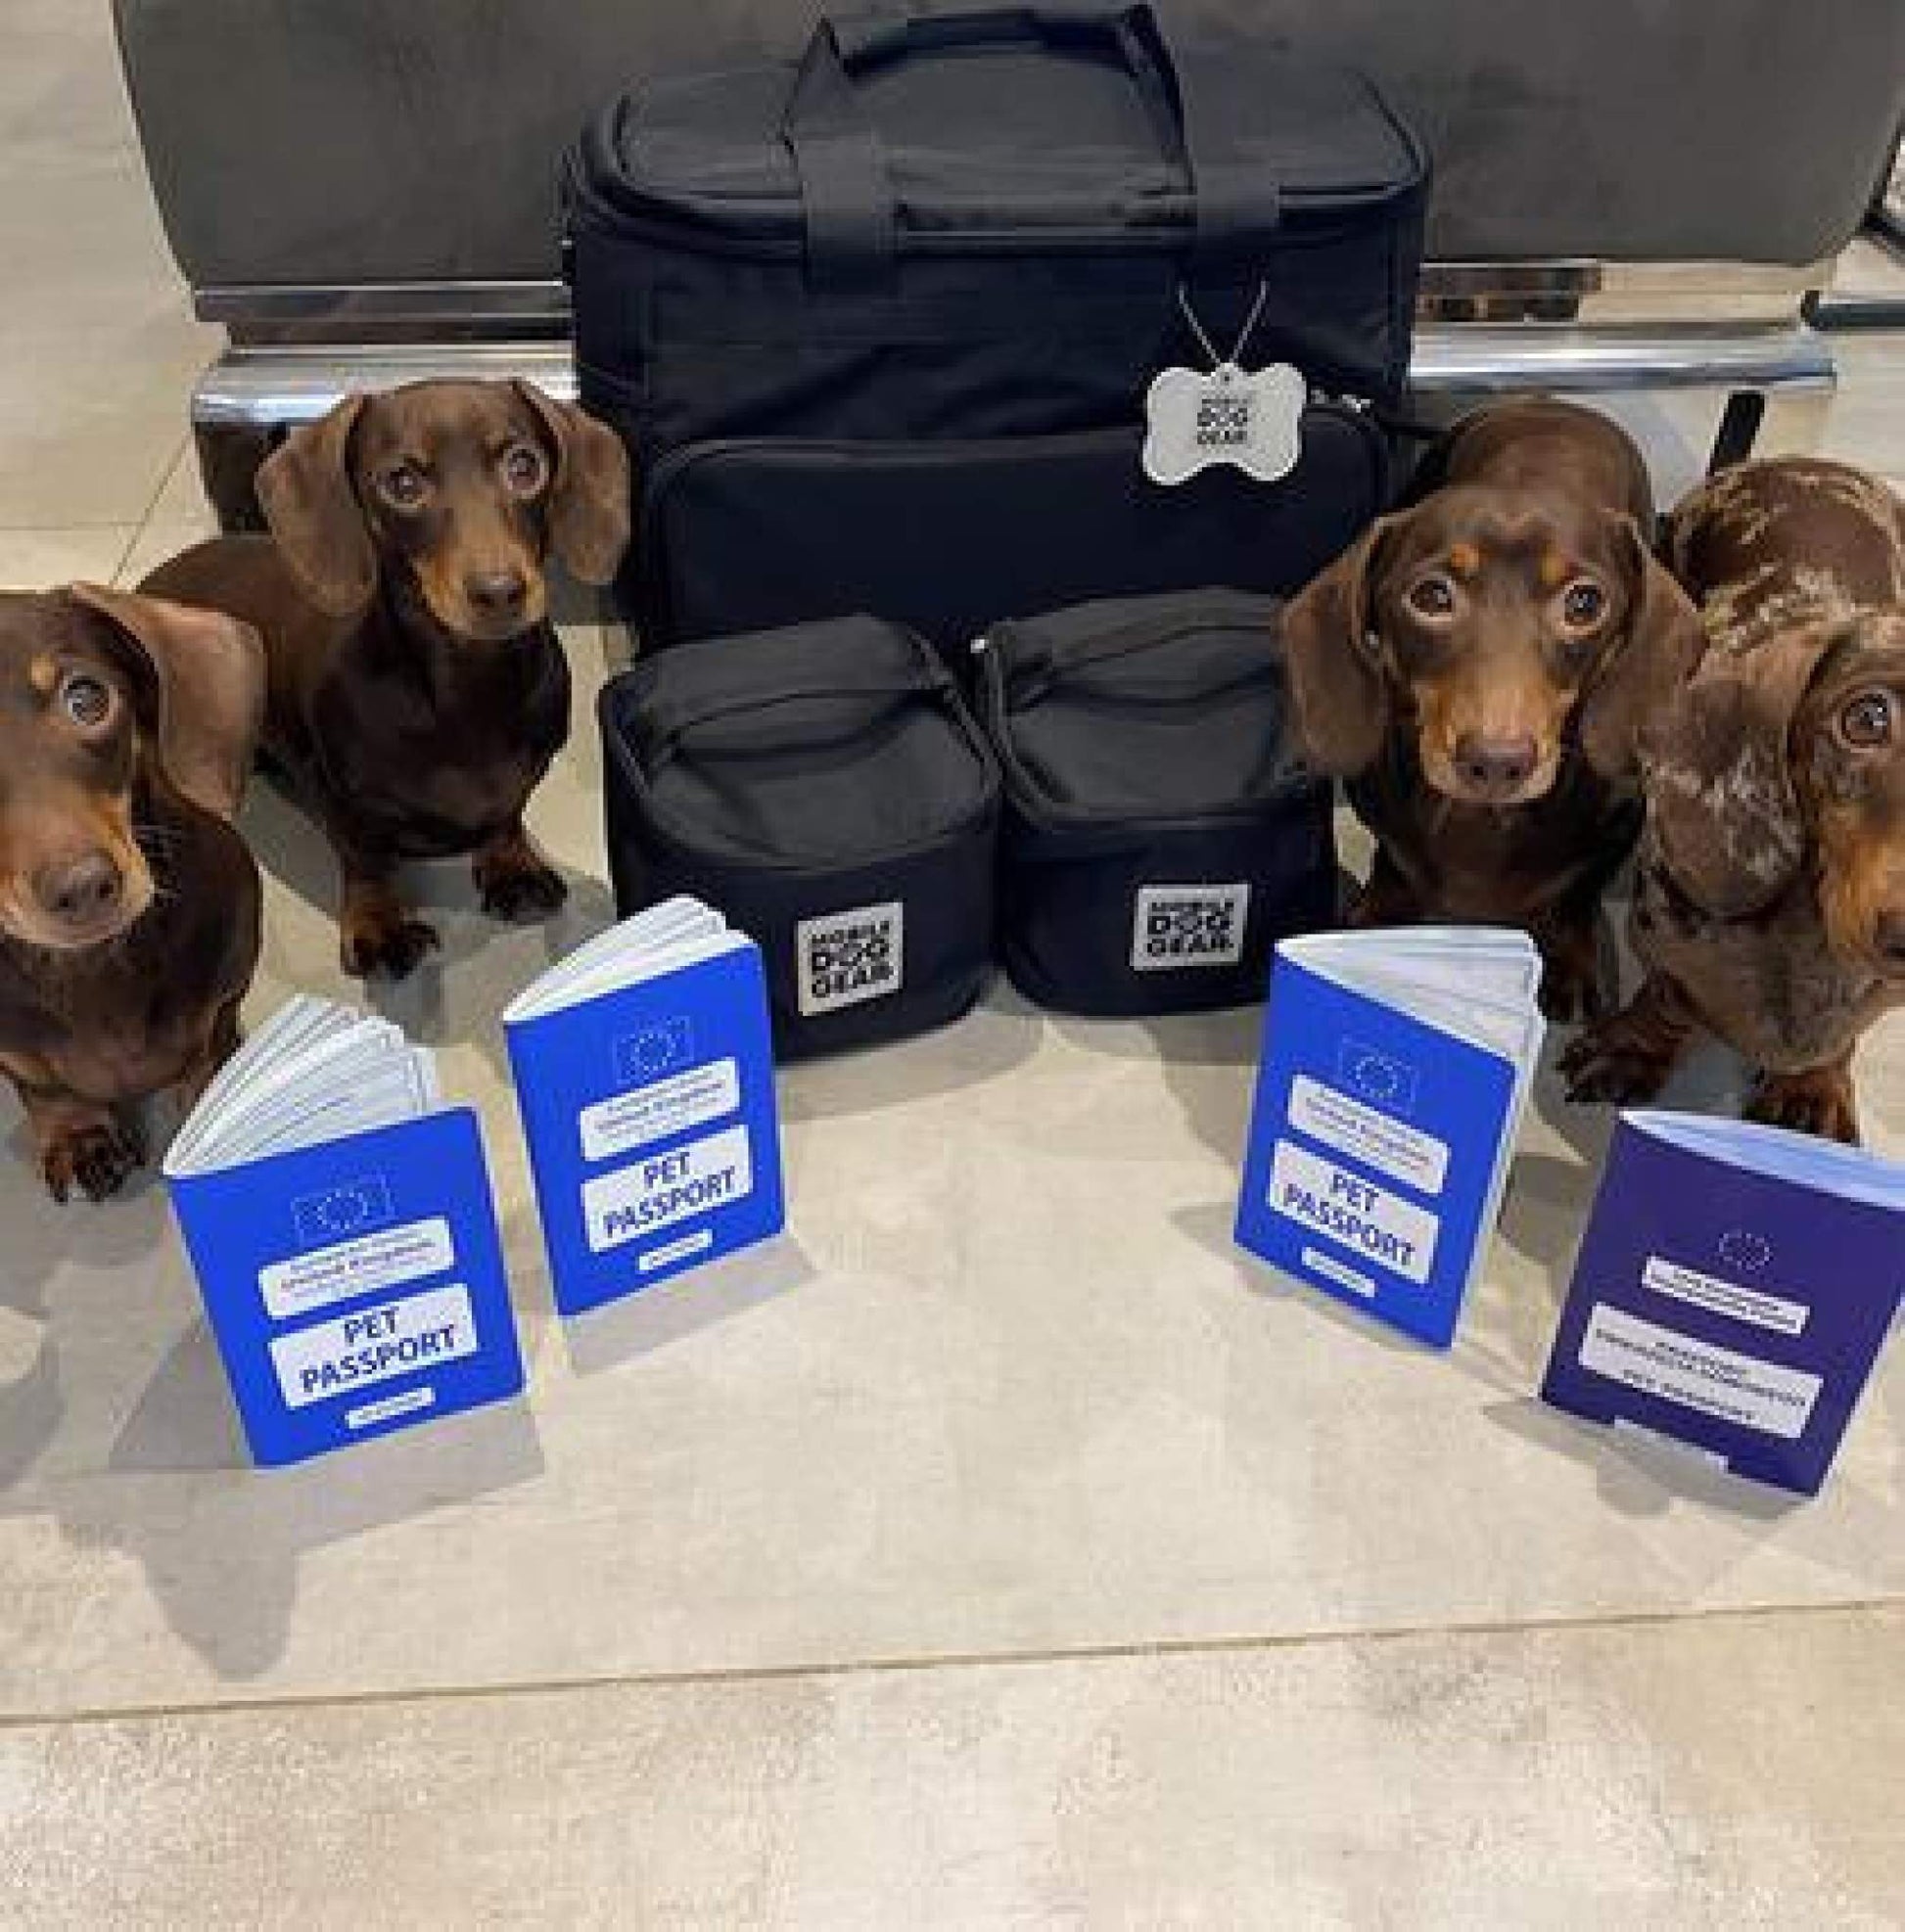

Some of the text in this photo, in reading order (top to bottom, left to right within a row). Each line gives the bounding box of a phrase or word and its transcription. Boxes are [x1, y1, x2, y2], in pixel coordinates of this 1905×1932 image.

[1147, 913, 1232, 936] DOG
[811, 937, 890, 975] DOG
[1146, 934, 1233, 957] GEAR
[811, 963, 894, 998] GEAR
[643, 1151, 690, 1188] PET
[602, 1165, 736, 1238] PASSPORT
[1332, 1173, 1379, 1213] PET
[1283, 1183, 1417, 1266] PASSPORT
[345, 1307, 400, 1346] PET
[300, 1323, 456, 1394] PASSPORT
